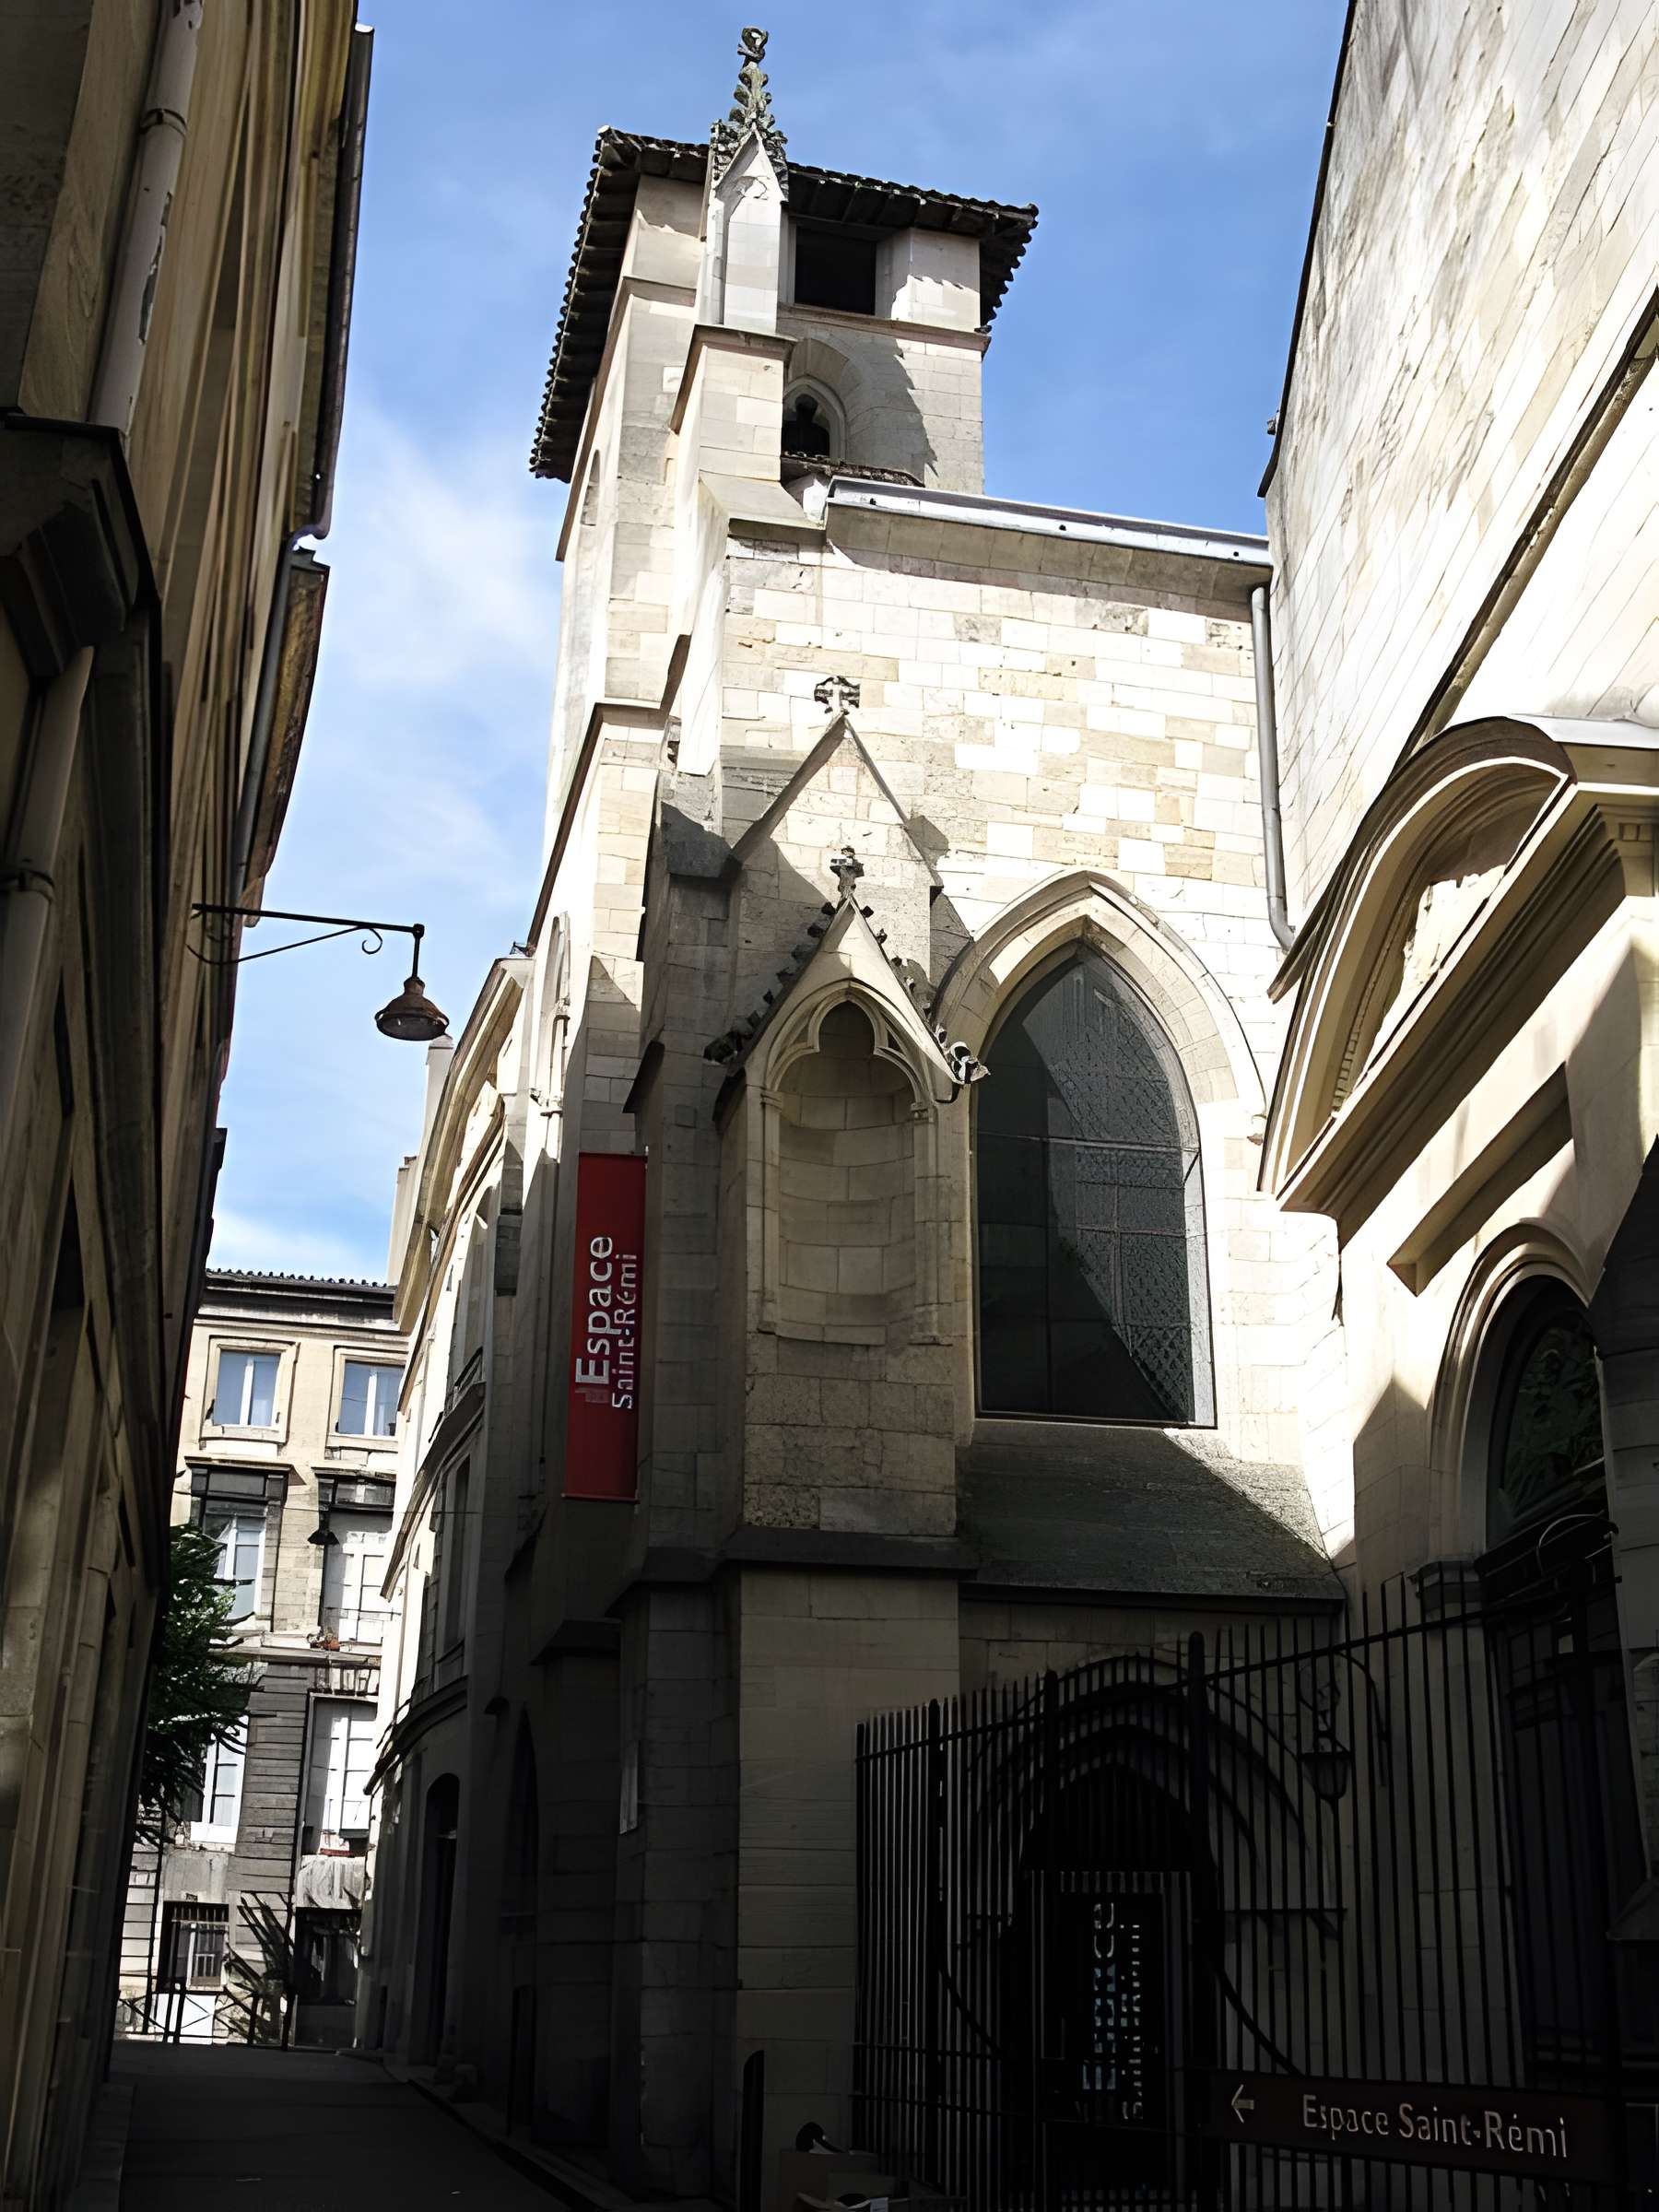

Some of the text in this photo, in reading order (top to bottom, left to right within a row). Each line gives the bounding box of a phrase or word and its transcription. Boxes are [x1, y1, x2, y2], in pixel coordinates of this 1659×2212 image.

[575, 1236, 621, 1384] Espace
[612, 1253, 637, 1409] Saint-Rémi
[1302, 2094, 1568, 2158] Espace Saint-Rémi
